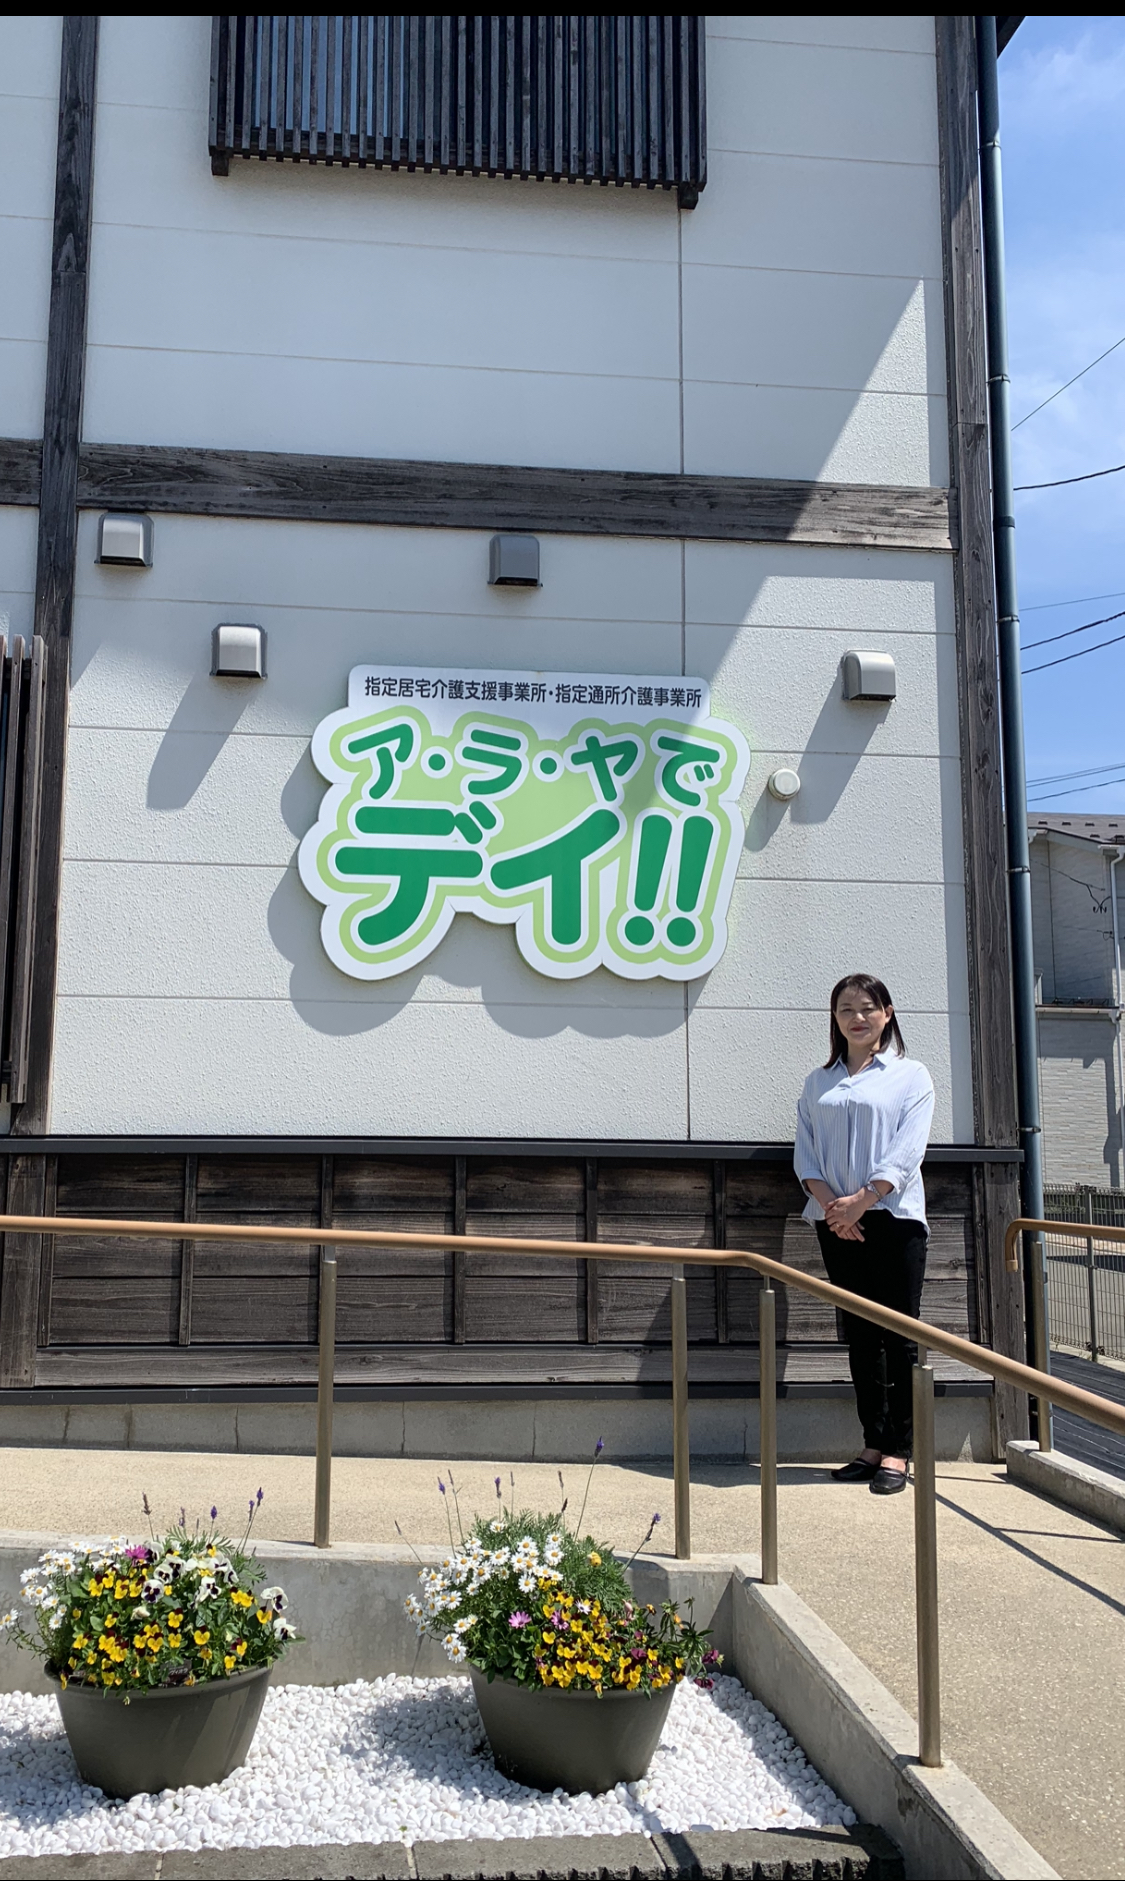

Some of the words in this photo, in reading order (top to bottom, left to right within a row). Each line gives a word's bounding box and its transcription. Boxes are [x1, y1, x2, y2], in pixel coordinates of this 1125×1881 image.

[365, 676, 702, 708] 指定居宅介護支援事業所・指定通所介護事業所
[348, 723, 720, 807] ア・ラ・ヤで
